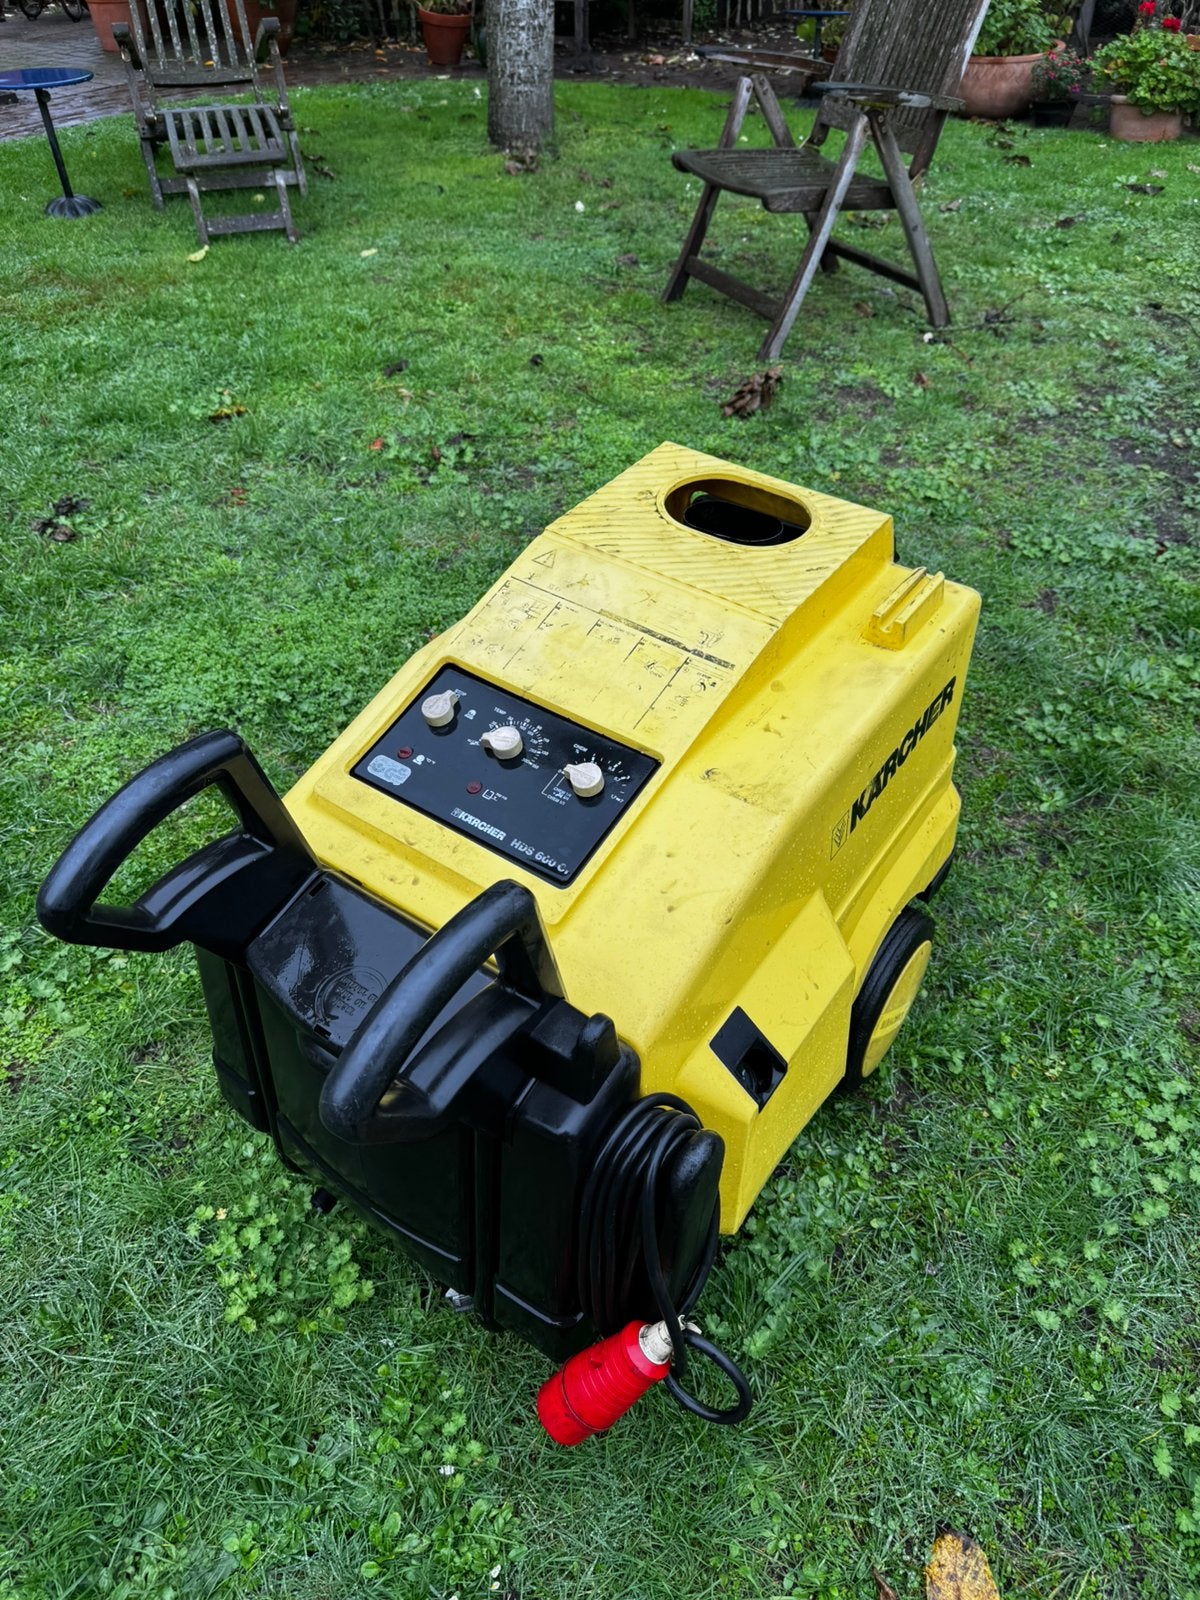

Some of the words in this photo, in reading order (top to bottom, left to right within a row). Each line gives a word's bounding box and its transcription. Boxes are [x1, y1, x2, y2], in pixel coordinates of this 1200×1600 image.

[493, 706, 506, 715] TEMP
[573, 743, 588, 752] CHEM
[458, 810, 507, 841] KÄRCHER
[510, 838, 536, 856] HDS
